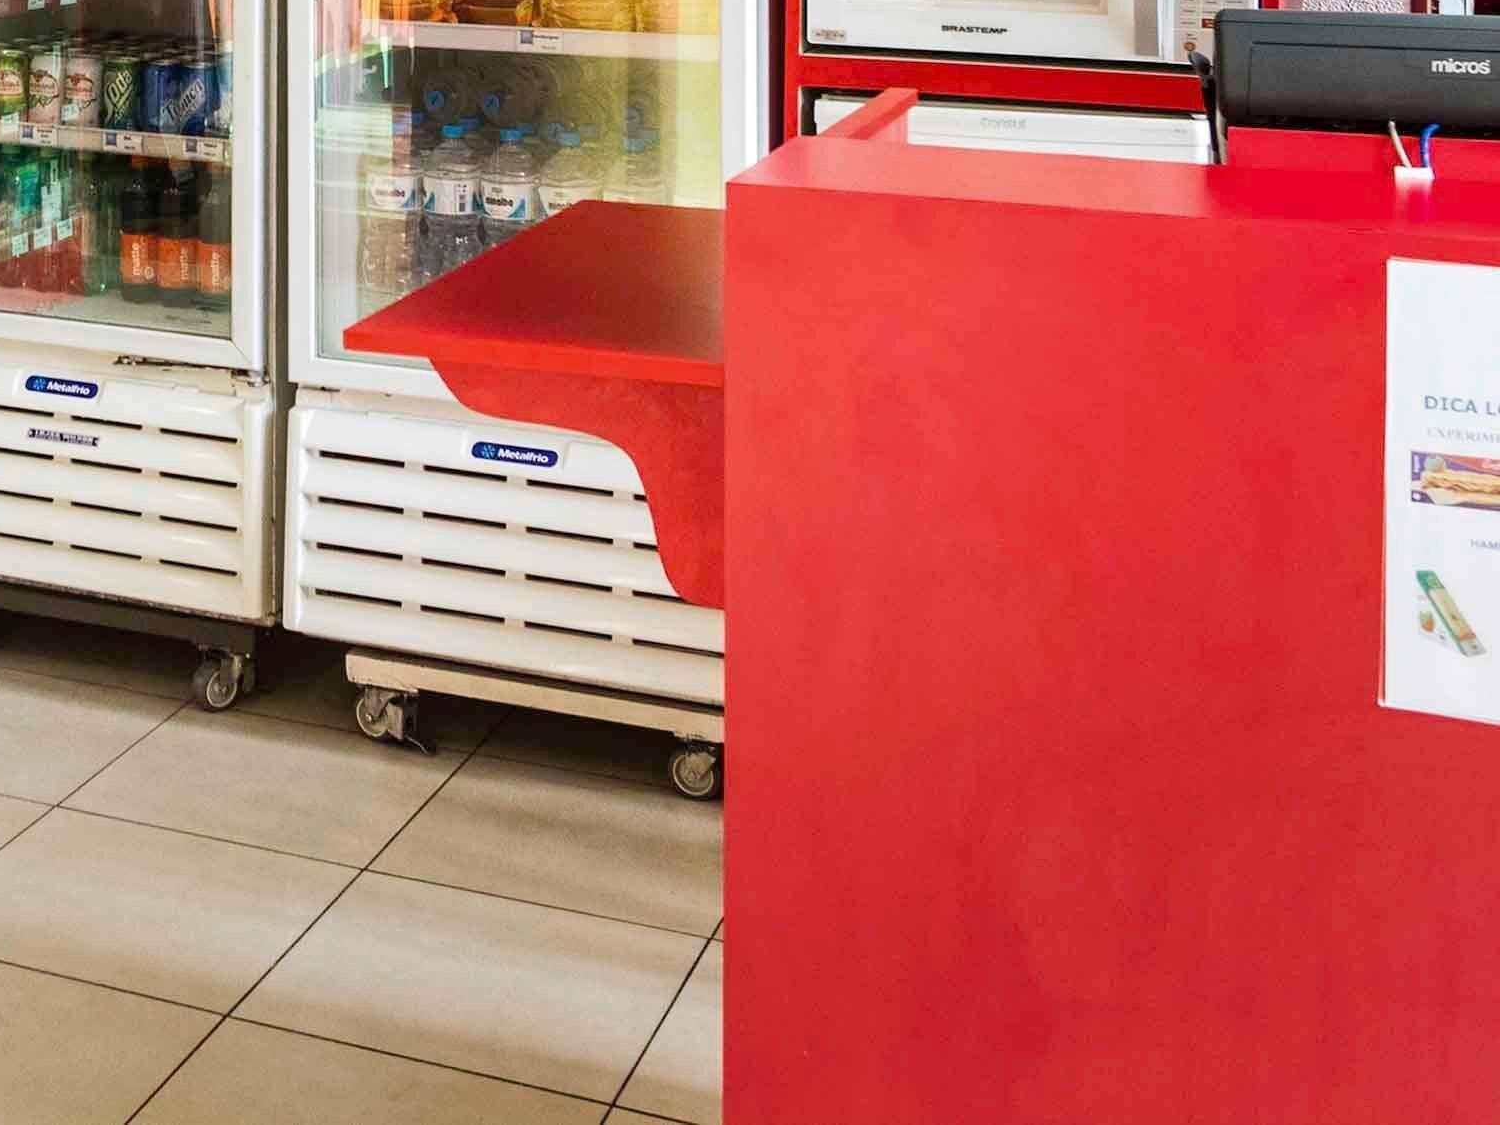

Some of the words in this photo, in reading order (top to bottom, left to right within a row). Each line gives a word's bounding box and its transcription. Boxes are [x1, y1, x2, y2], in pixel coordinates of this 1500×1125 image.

[941, 25, 1008, 34] BRASTEMP
[1431, 58, 1491, 75] micros
[46, 380, 91, 395] Metalfrio
[1423, 395, 1478, 414] DICA
[497, 448, 549, 463] Metalfrio
